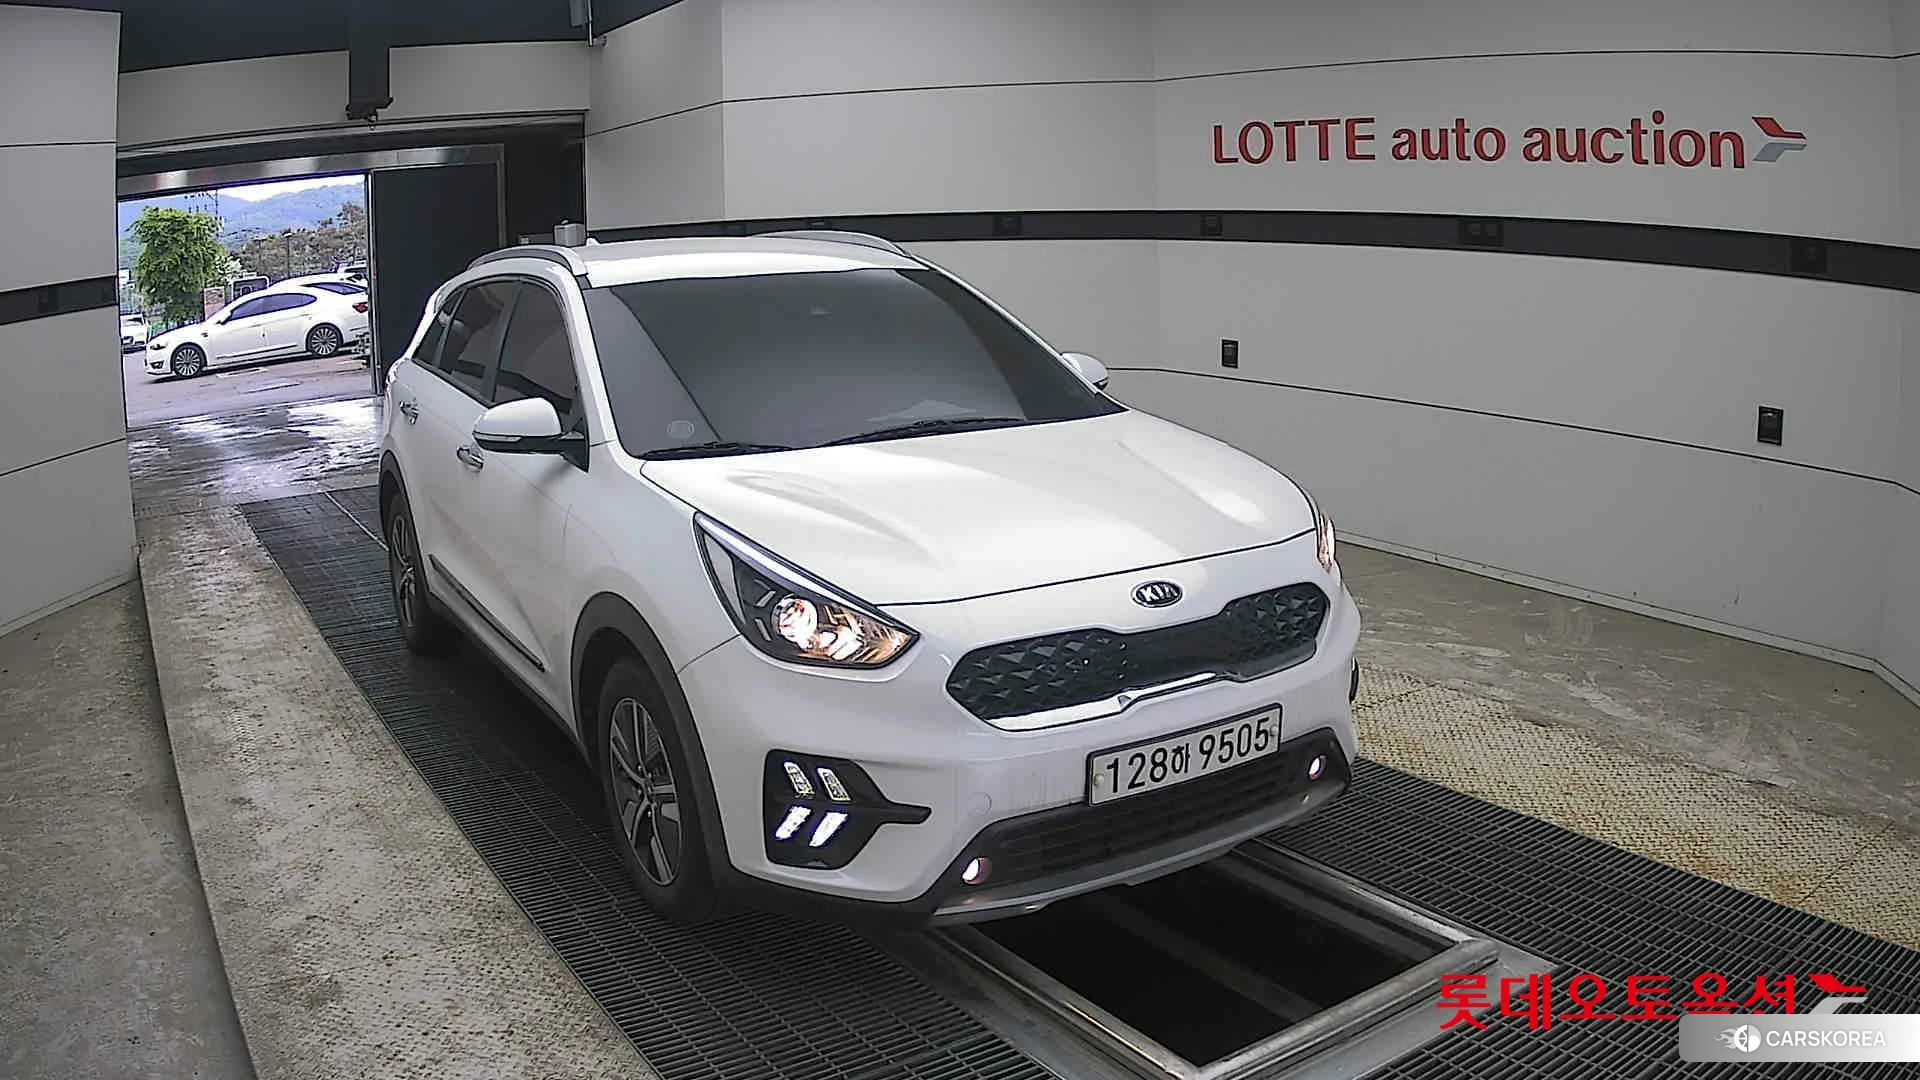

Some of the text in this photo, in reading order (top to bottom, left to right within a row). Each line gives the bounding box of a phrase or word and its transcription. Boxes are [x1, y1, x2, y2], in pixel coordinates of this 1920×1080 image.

[1212, 109, 1745, 169] LOTTE auto auction
[1137, 582, 1179, 603] KIA
[1106, 716, 1270, 794] 128하 9505
